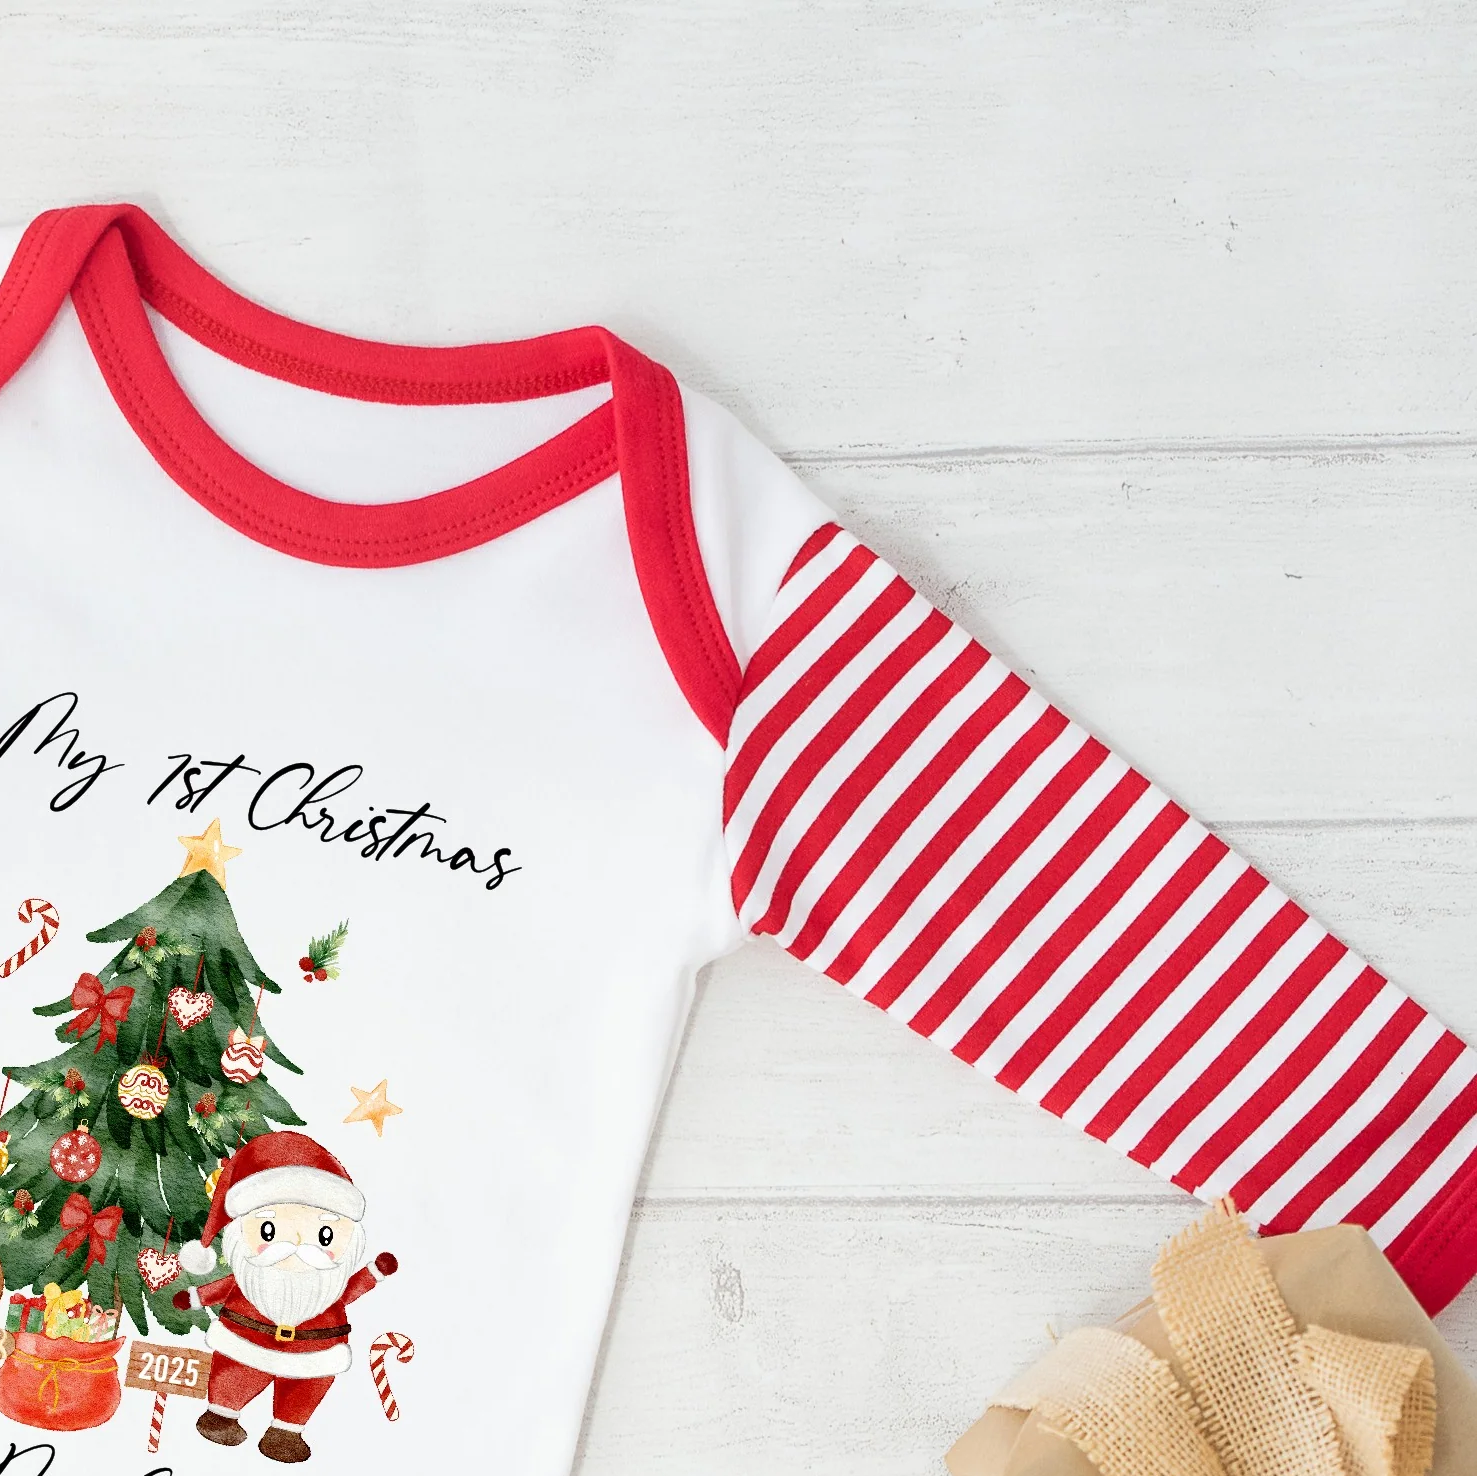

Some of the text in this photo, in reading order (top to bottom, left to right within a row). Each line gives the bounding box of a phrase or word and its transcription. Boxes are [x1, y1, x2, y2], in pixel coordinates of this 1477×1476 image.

[146, 753, 262, 814] 1st
[247, 762, 523, 891] Christmas
[138, 1351, 201, 1387] 2025
